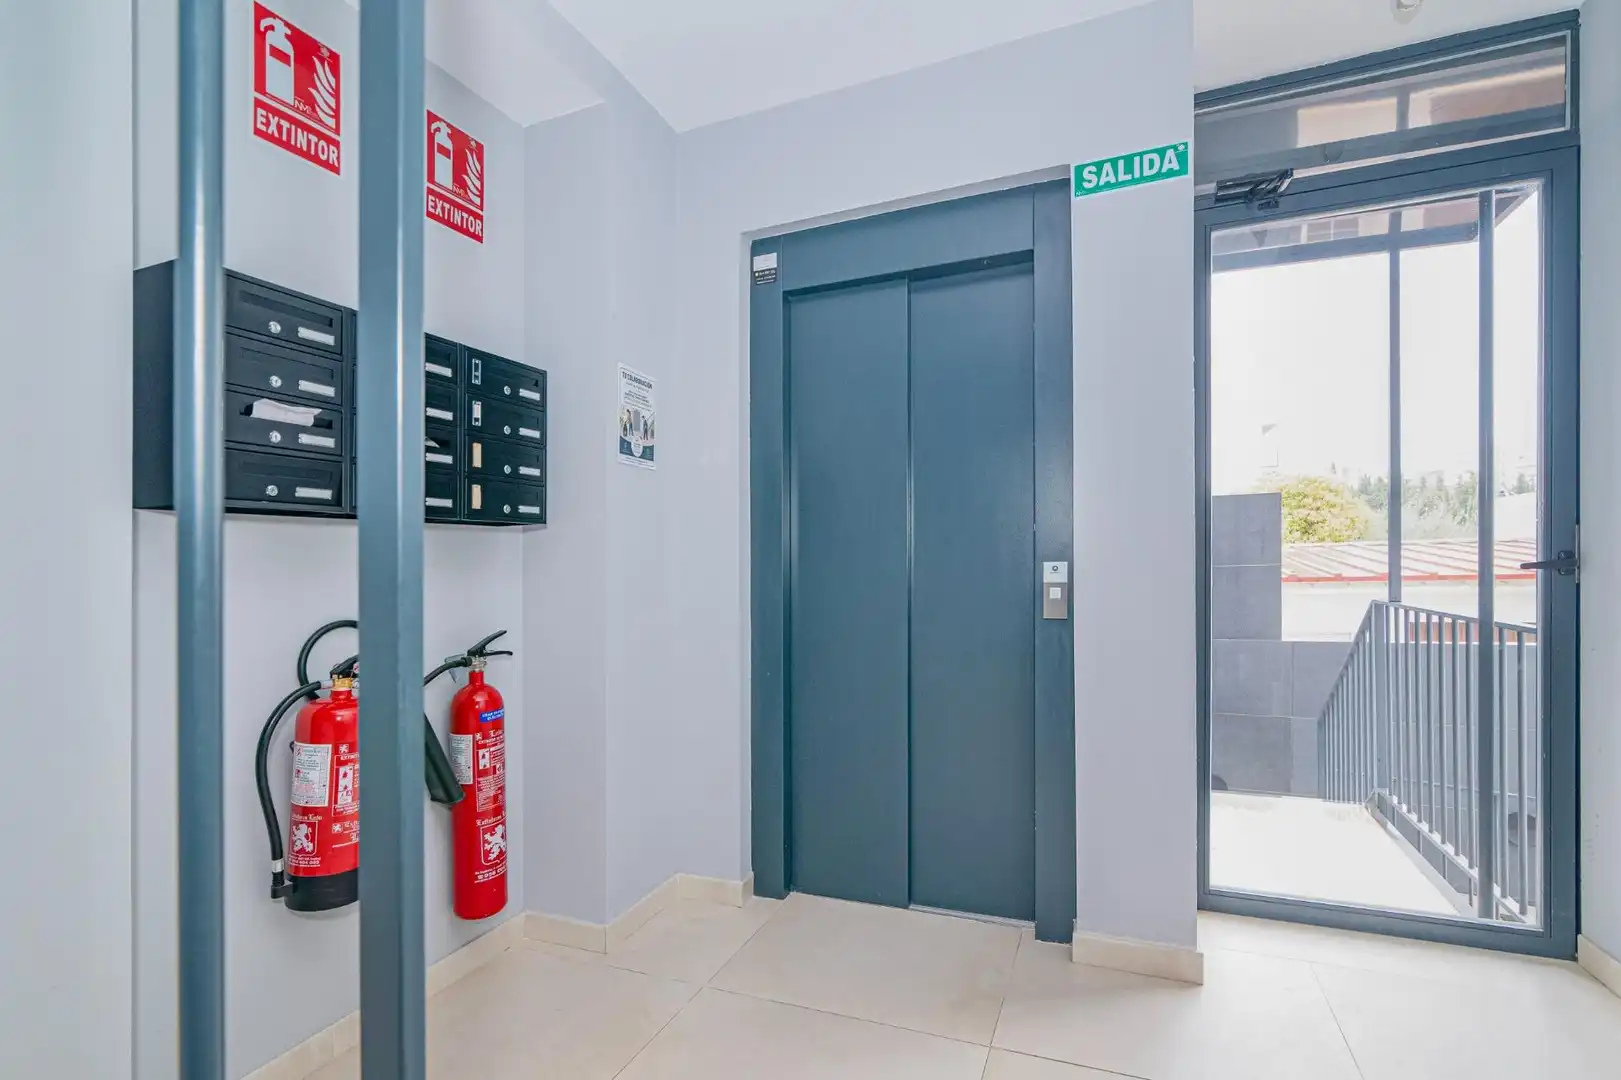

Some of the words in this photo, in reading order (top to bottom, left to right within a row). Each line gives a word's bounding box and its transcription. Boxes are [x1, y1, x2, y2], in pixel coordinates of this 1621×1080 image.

[256, 107, 339, 167] EXTINTOR
[1082, 148, 1180, 189] SALIDA
[427, 194, 482, 236] EXTINTOR
